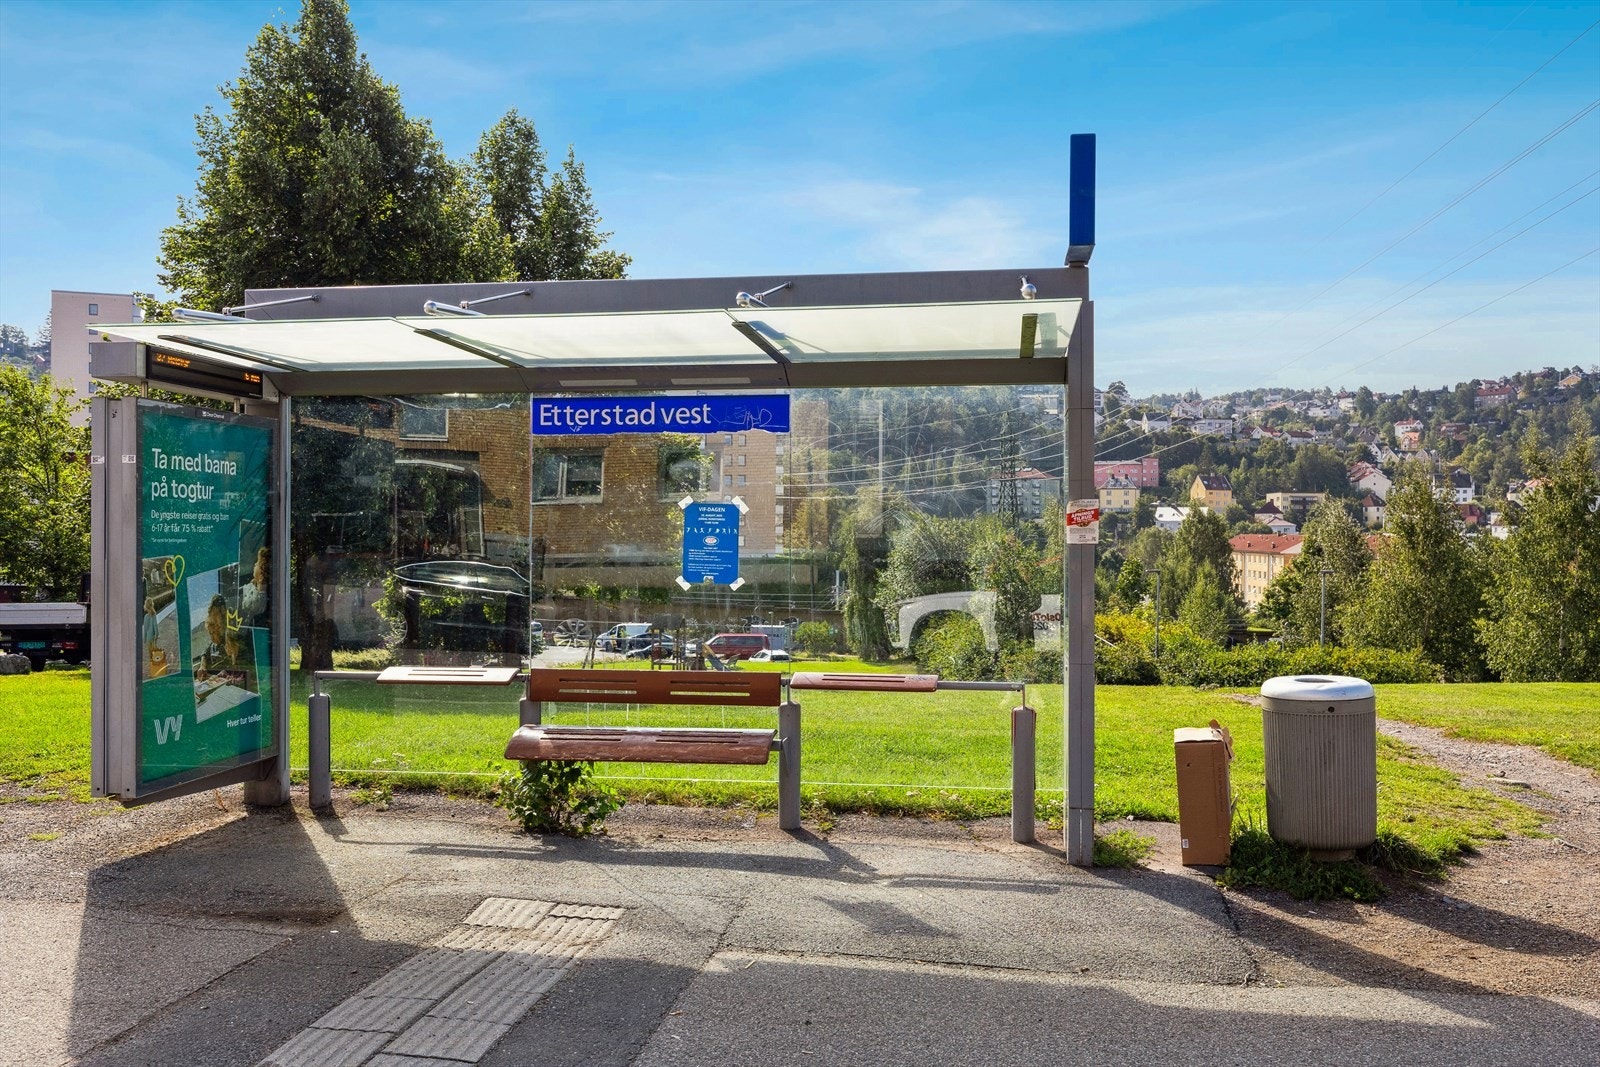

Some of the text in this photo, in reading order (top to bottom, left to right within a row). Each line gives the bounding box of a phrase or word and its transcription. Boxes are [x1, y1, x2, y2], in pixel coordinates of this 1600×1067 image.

[539, 401, 655, 426] Etterstad
[660, 403, 711, 425] vest
[152, 447, 237, 475] Ta med barna
[151, 475, 215, 503] på togtur
[150, 509, 159, 519] De
[159, 510, 180, 521] yngste
[181, 510, 197, 520] reiser
[212, 513, 219, 522] og
[151, 523, 163, 533] 6-17
[171, 523, 181, 533] får
[182, 523, 190, 533] 75
